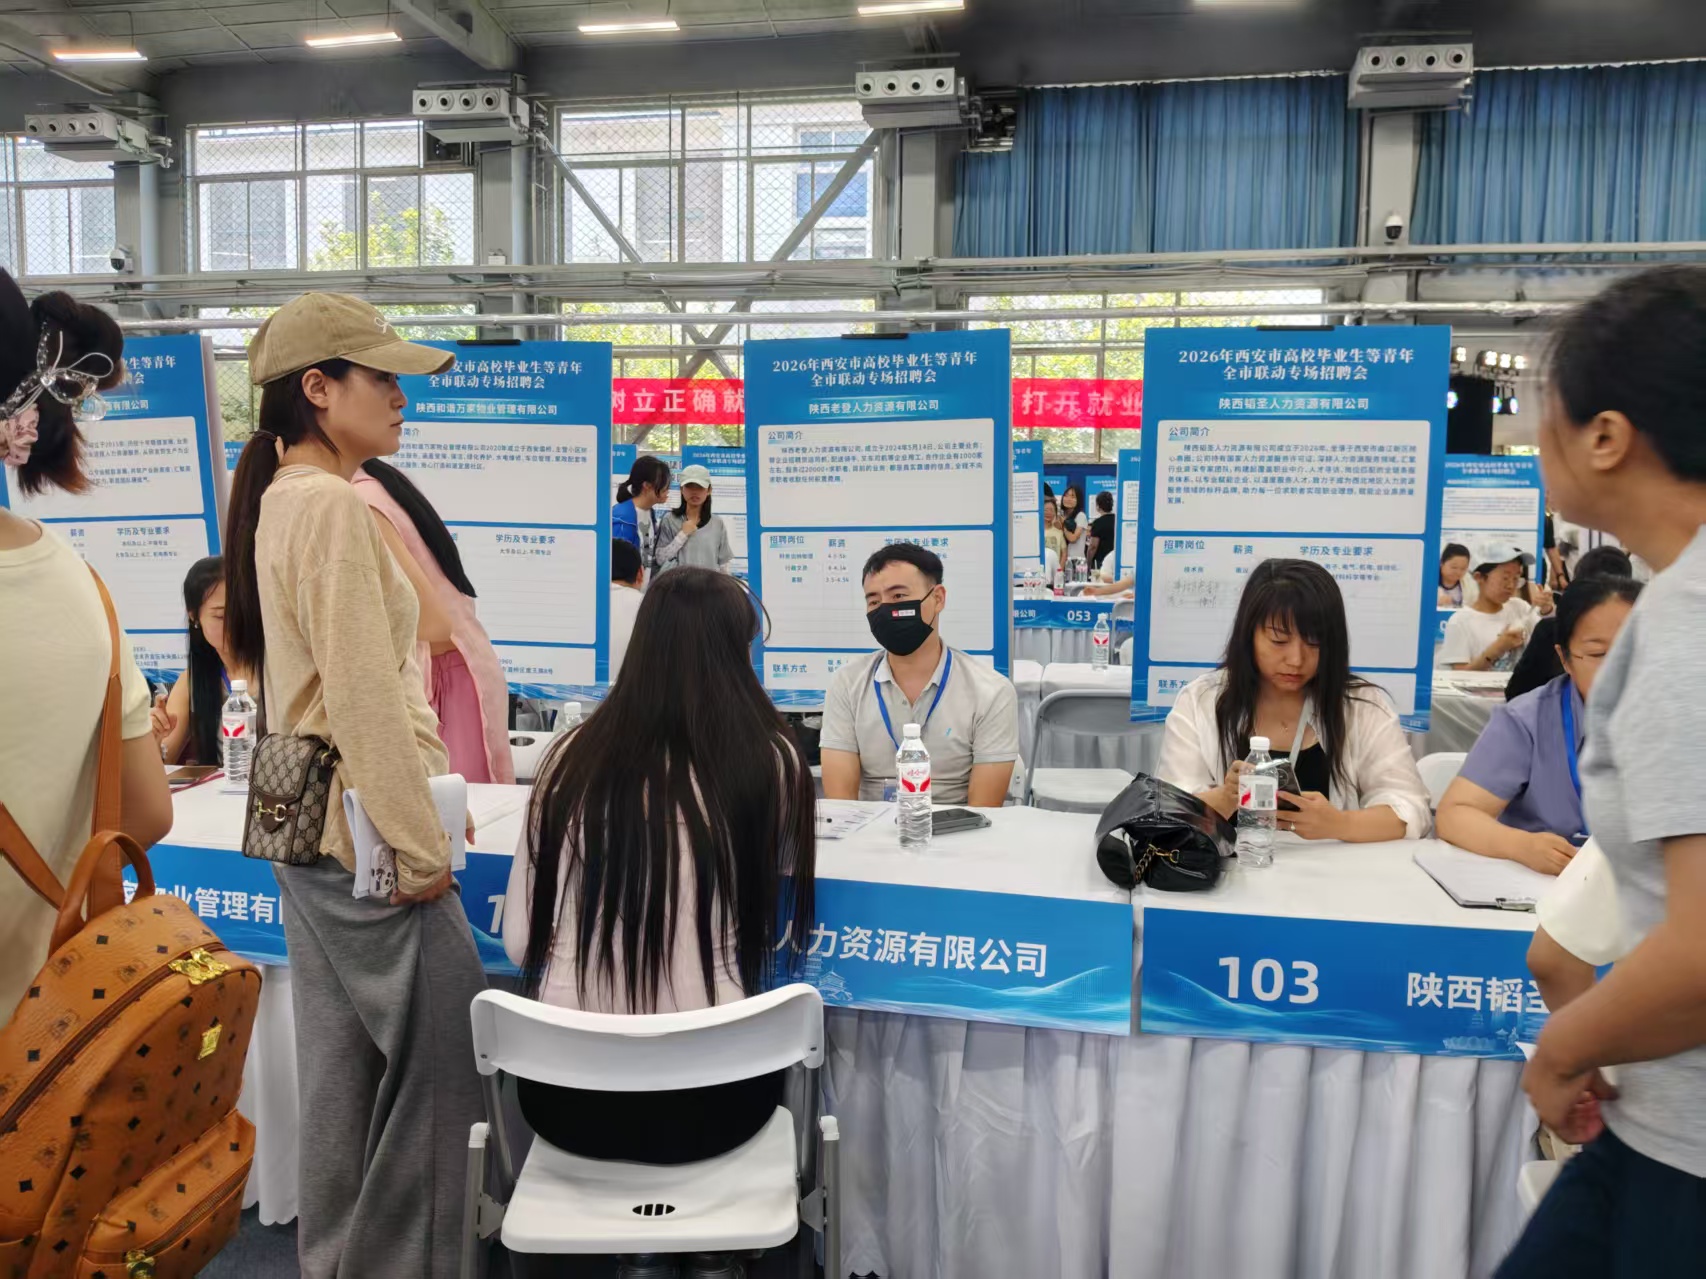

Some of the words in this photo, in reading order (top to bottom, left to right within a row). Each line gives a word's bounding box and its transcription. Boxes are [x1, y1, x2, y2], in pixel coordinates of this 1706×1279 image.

[773, 351, 977, 373] 2026年西安市高校毕业生等青年
[1178, 349, 1414, 364] 2026年西安市高校毕业生等青年
[811, 369, 937, 388] 全市联动专场招聘会
[1223, 365, 1368, 381] 全市联动专场招聘会
[428, 375, 545, 389] 全市联动专场招聘会
[416, 402, 557, 416] 陕西和谐万家物业管理有限公司
[808, 399, 939, 415] 陕西老登人力资源有限公司
[1219, 397, 1369, 410] 陕西韬圣人力资源有限公司
[768, 431, 803, 441] 公司简介
[1169, 427, 1210, 437] 公司简介
[116, 526, 170, 536] 学历及专业要求
[496, 534, 556, 544] 学历及专业要求
[770, 535, 804, 545] 招聘岗位
[828, 538, 846, 548] 薪资
[1164, 539, 1205, 550] 招聘岗位
[1233, 544, 1253, 555] 薪资
[1300, 545, 1374, 556] 学历及专业要求
[1067, 610, 1091, 622] 053
[772, 664, 807, 673] 联系方式
[1218, 956, 1319, 1004] 103
